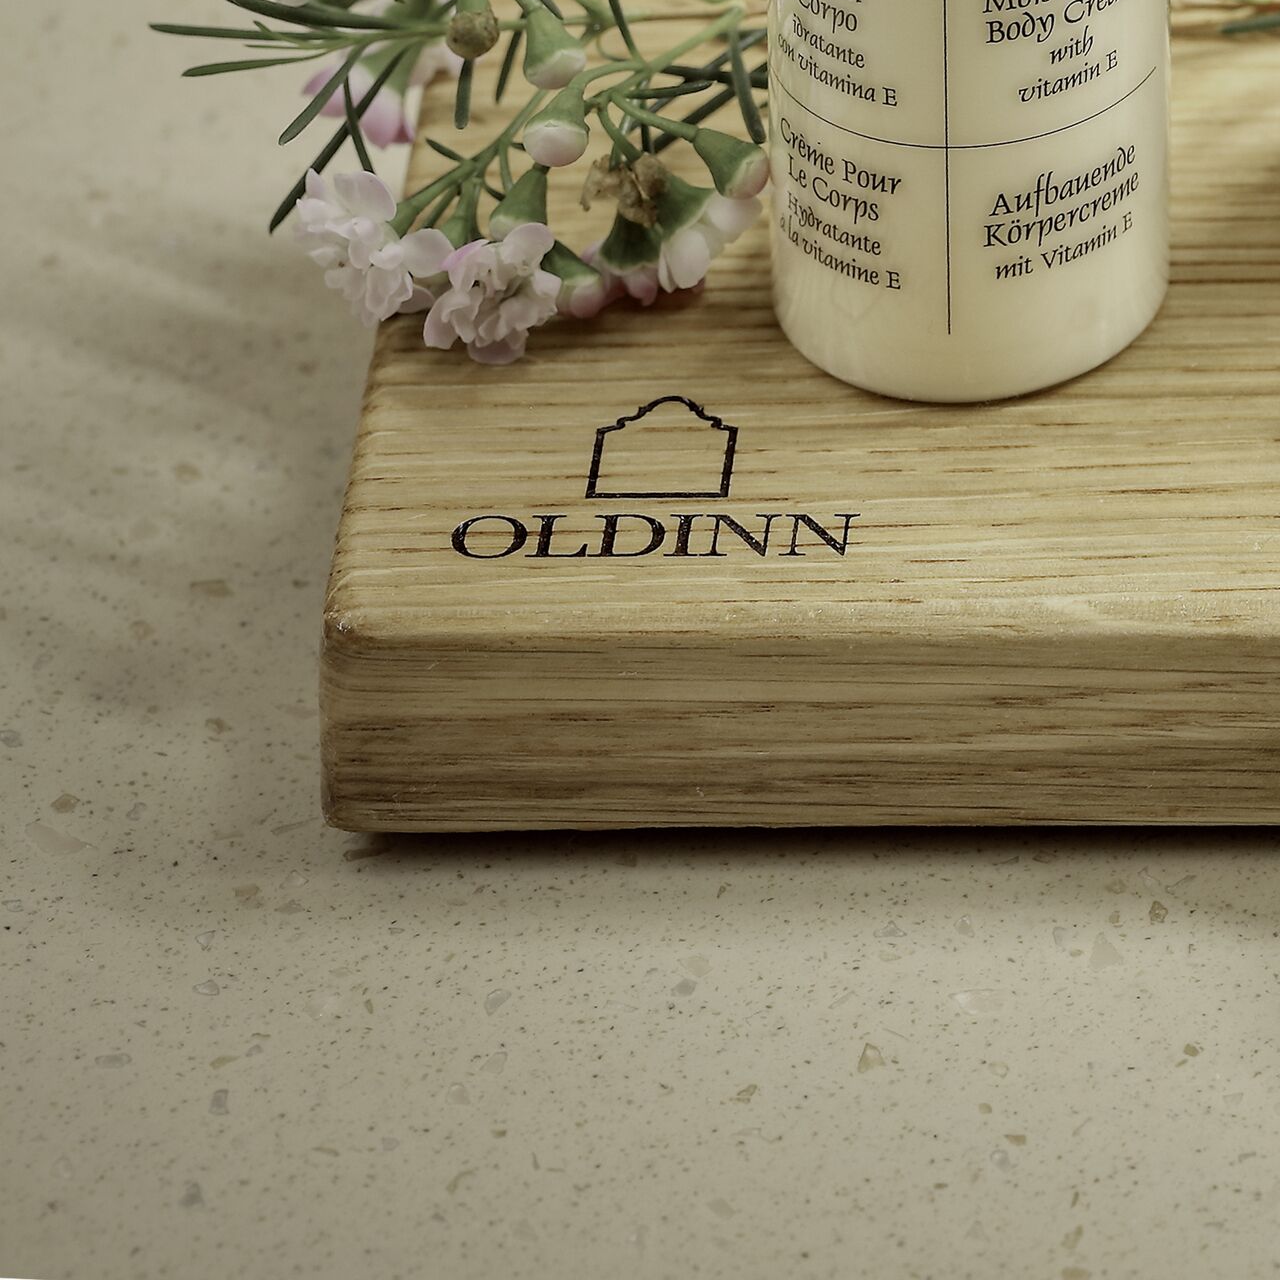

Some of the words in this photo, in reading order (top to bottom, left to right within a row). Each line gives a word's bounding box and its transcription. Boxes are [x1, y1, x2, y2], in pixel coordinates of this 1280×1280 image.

[792, 13, 865, 68] idratante
[986, 11, 1055, 44] Body
[1050, 25, 1094, 64] with
[778, 34, 795, 62] con
[798, 56, 876, 102] vitamina
[882, 86, 897, 107] E
[1019, 62, 1100, 102] vitamin
[1106, 49, 1118, 72] E
[781, 117, 835, 175] Crème
[842, 159, 901, 194] Pour
[788, 153, 807, 188] Le
[812, 176, 879, 224] Corps
[989, 145, 1136, 217] Aufbauende
[788, 191, 881, 255] Hydratante
[983, 172, 1139, 247] Körpercreme
[788, 215, 799, 247] la
[803, 238, 880, 285] vitamine
[886, 270, 901, 290] E
[996, 256, 1034, 280] mit
[1041, 225, 1117, 269] Vitamin
[1122, 212, 1133, 233] E
[451, 512, 861, 559] OLDINN
